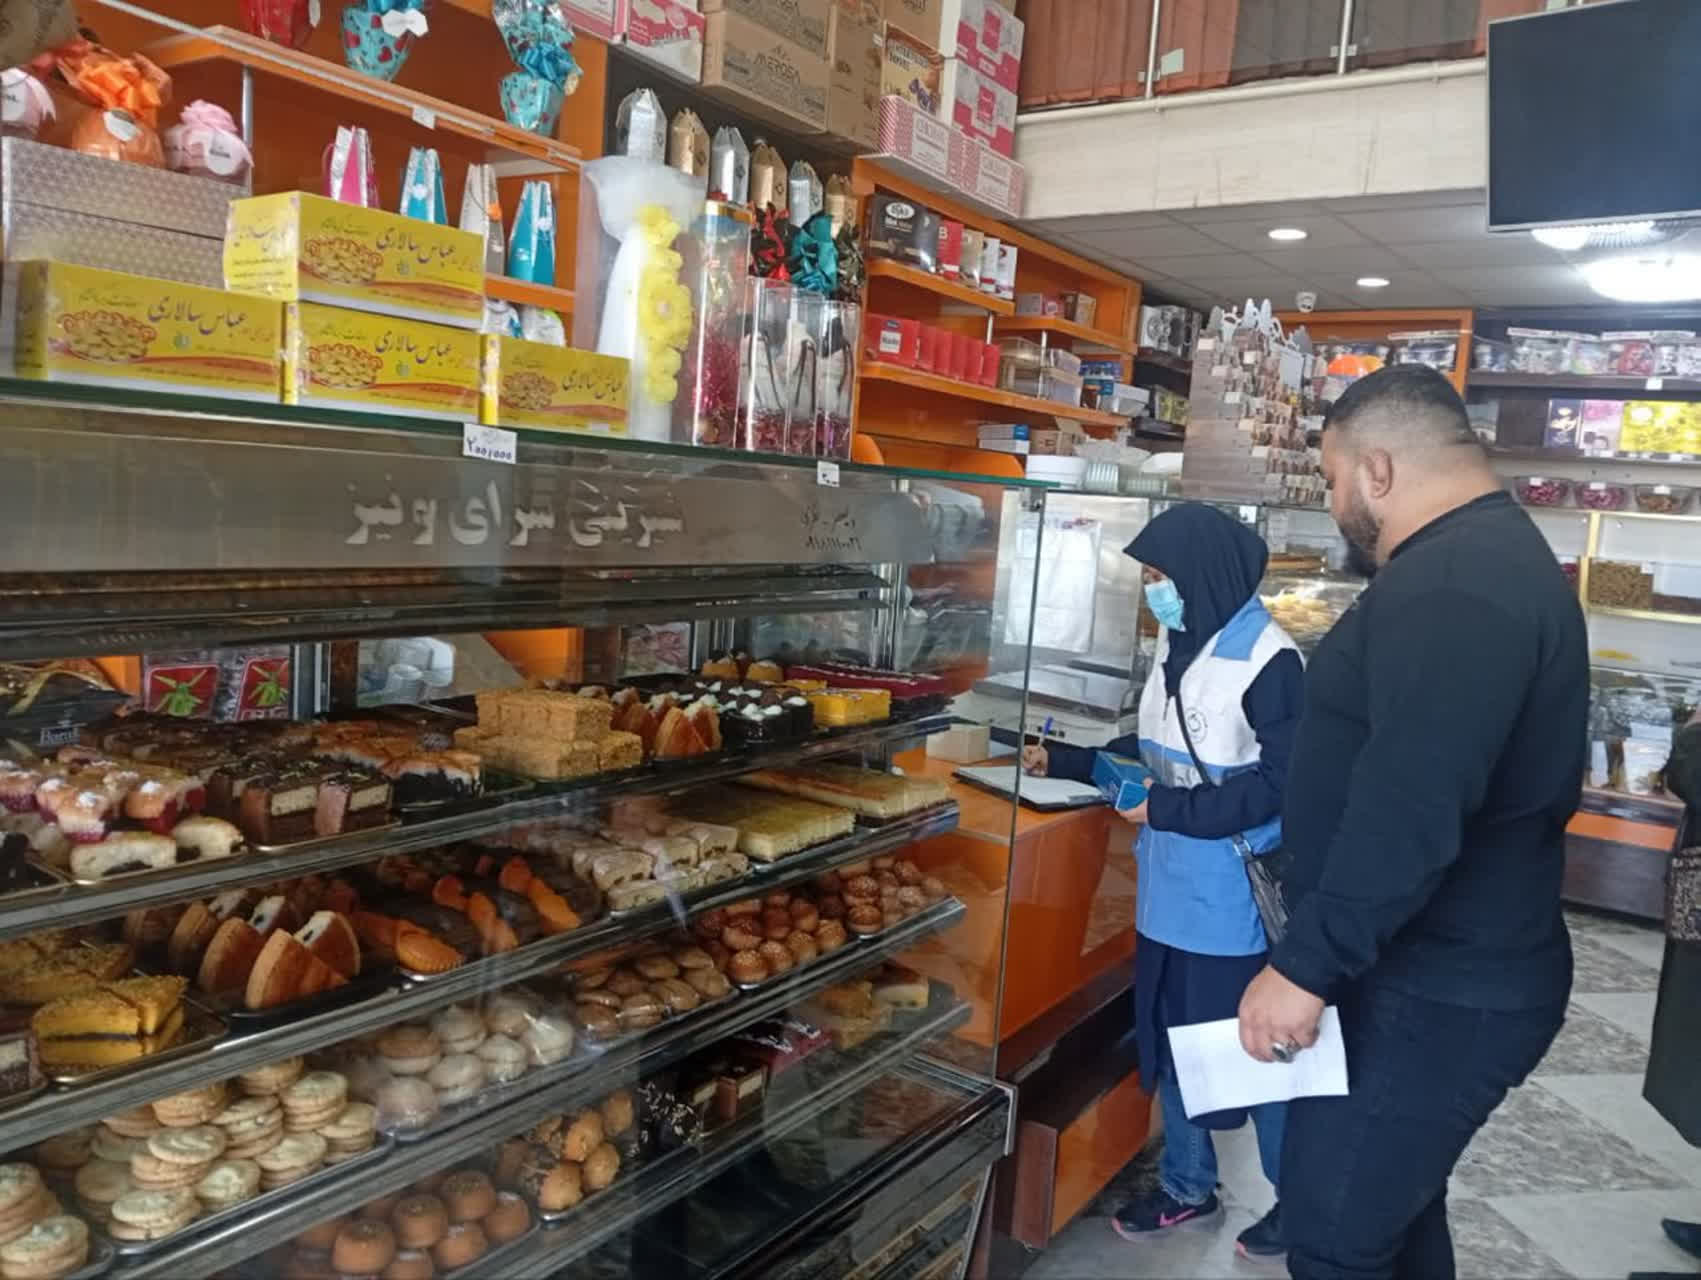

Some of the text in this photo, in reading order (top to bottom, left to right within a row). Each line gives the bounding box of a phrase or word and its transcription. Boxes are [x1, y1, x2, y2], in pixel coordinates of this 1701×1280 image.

[416, 240, 456, 268] عباس
[199, 307, 247, 337] عباس
[415, 341, 452, 366] عباس
